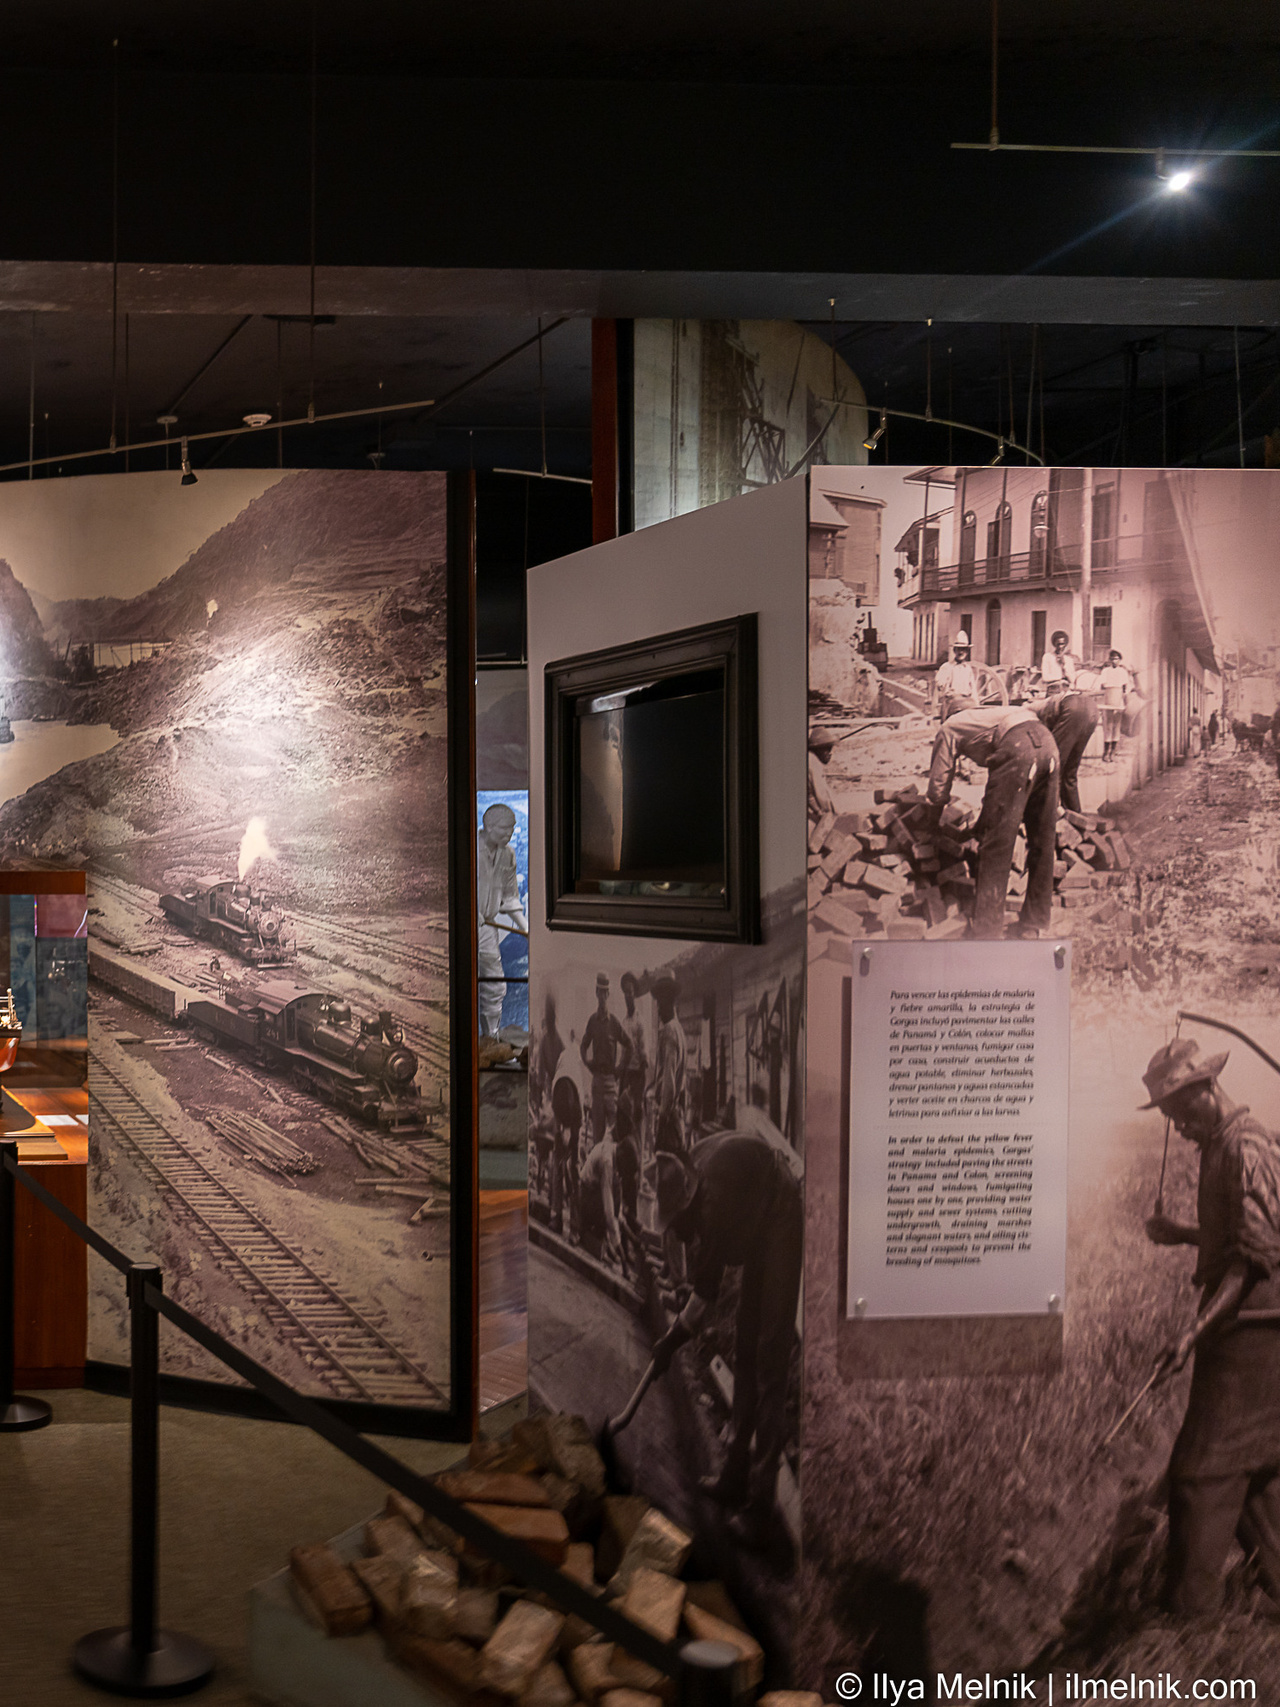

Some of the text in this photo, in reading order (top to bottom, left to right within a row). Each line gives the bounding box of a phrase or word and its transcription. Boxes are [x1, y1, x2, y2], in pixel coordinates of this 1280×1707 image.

[890, 991, 909, 999] Para
[938, 990, 949, 999] las
[950, 990, 991, 1001] epidemias
[991, 989, 1001, 998] de
[1003, 989, 1035, 998] malaria
[900, 1003, 923, 1012] fiebre
[968, 1003, 976, 1011] la
[981, 1003, 1020, 1013] estrategia
[1025, 1002, 1035, 1011] de
[890, 1017, 918, 1028] Gorgas
[951, 1016, 998, 1027] pavimentar
[1000, 1015, 1011, 1024] las
[1013, 1015, 1034, 1025] calles
[890, 1030, 900, 1039] de
[903, 1030, 937, 1039] Panamá
[901, 1044, 932, 1054] puertas
[981, 1042, 1014, 1052] fumigar
[889, 1058, 903, 1067] por
[933, 1056, 970, 1065] construir
[975, 1054, 1019, 1064] acueductos
[1024, 1054, 1034, 1063] de
[889, 1072, 910, 1081] agua
[951, 1068, 986, 1077] eliminar
[889, 1083, 917, 1092] drenar
[917, 1083, 956, 1093] pantanos
[963, 1083, 988, 1092] aguas
[989, 1080, 1034, 1090] estancadas
[897, 1097, 919, 1105] verter
[921, 1096, 946, 1104] aceite
[993, 1094, 1004, 1103] de
[1005, 1096, 1026, 1105] agua
[889, 1109, 919, 1118] letrinas
[920, 1110, 940, 1119] para
[981, 1107, 993, 1116] las
[888, 1133, 1033, 1145] In order to defeat the yellow fever
[888, 1148, 905, 1157] and
[912, 1147, 947, 1156] malaria
[888, 1158, 1033, 1171] strategy included paving the streets
[888, 1173, 897, 1181] in
[901, 1172, 937, 1181] Panama
[942, 1171, 959, 1180] and
[994, 1169, 1033, 1180] screening
[887, 1184, 910, 1193] doors
[917, 1183, 934, 1193] and
[985, 1182, 1033, 1193] fumigating
[887, 1196, 915, 1205] houses
[935, 1195, 945, 1206] by
[966, 1194, 1006, 1206] providing
[1009, 1194, 1032, 1203] water
[887, 1208, 914, 1220] supply
[918, 1208, 935, 1217] and
[1002, 1206, 1033, 1217] cutting
[951, 1218, 988, 1229] draining
[997, 1218, 1032, 1228] marshes
[886, 1232, 903, 1242] and
[973, 1231, 991, 1240] and
[992, 1231, 1016, 1241] oiling
[886, 1246, 908, 1254] terns
[910, 1245, 928, 1254] and
[971, 1244, 980, 1252] to
[983, 1243, 1014, 1254] prevent
[1017, 1242, 1032, 1251] the
[886, 1257, 922, 1268] breeding
[923, 1256, 934, 1265] of
